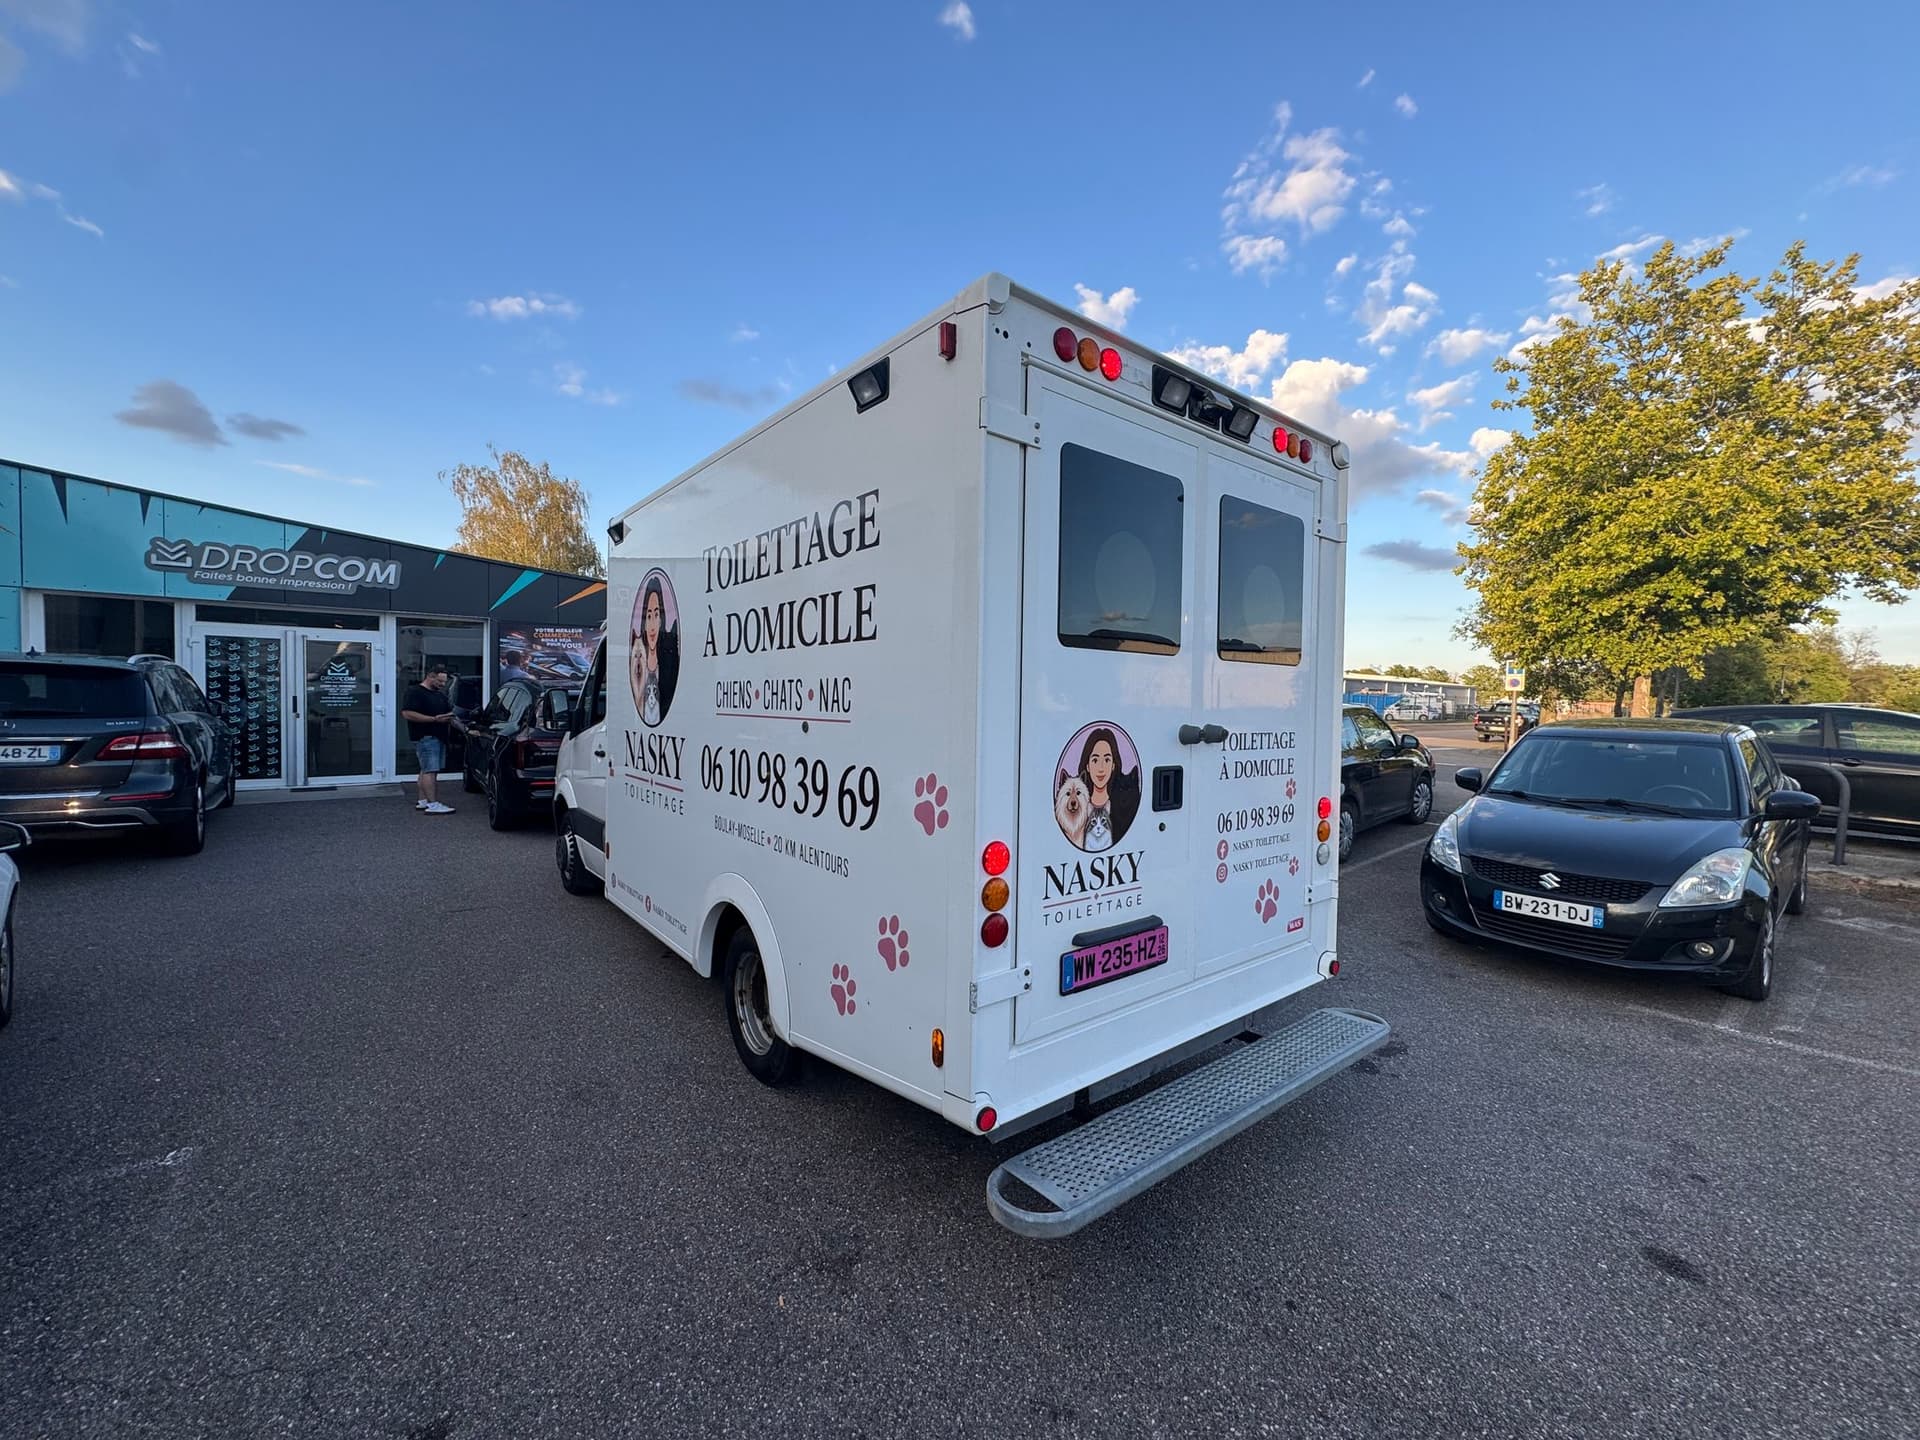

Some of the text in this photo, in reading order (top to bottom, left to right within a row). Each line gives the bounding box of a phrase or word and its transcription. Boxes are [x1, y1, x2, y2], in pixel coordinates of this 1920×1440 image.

[702, 488, 881, 594] TOILETTAGE
[193, 570, 233, 582] Faites
[236, 572, 277, 585] bonne
[280, 576, 346, 591] impression
[199, 545, 397, 585] DROPCOM
[702, 583, 878, 658] À DOMICILE
[715, 677, 852, 713] CHIENS CHATS NAC
[624, 730, 686, 781] NASKY
[1219, 756, 1295, 780] À DOMICILE
[624, 782, 684, 815] TOILETTAGE
[700, 744, 880, 831] 06 10 98 39 69
[1217, 803, 1295, 834] 06 10 98 39 69
[714, 815, 850, 878] BOULAY-MOSELLE 20 KM ALENTOURS
[1232, 832, 1291, 852] NASKY TOILETTAGE
[1042, 850, 1145, 901] NASKY
[1232, 853, 1290, 873] NASKY TOILETTAGE
[1042, 894, 1142, 926] TOILETTAGE
[1504, 895, 1590, 922] BW-231-DJ
[1073, 935, 1157, 983] WW-235-HZ
